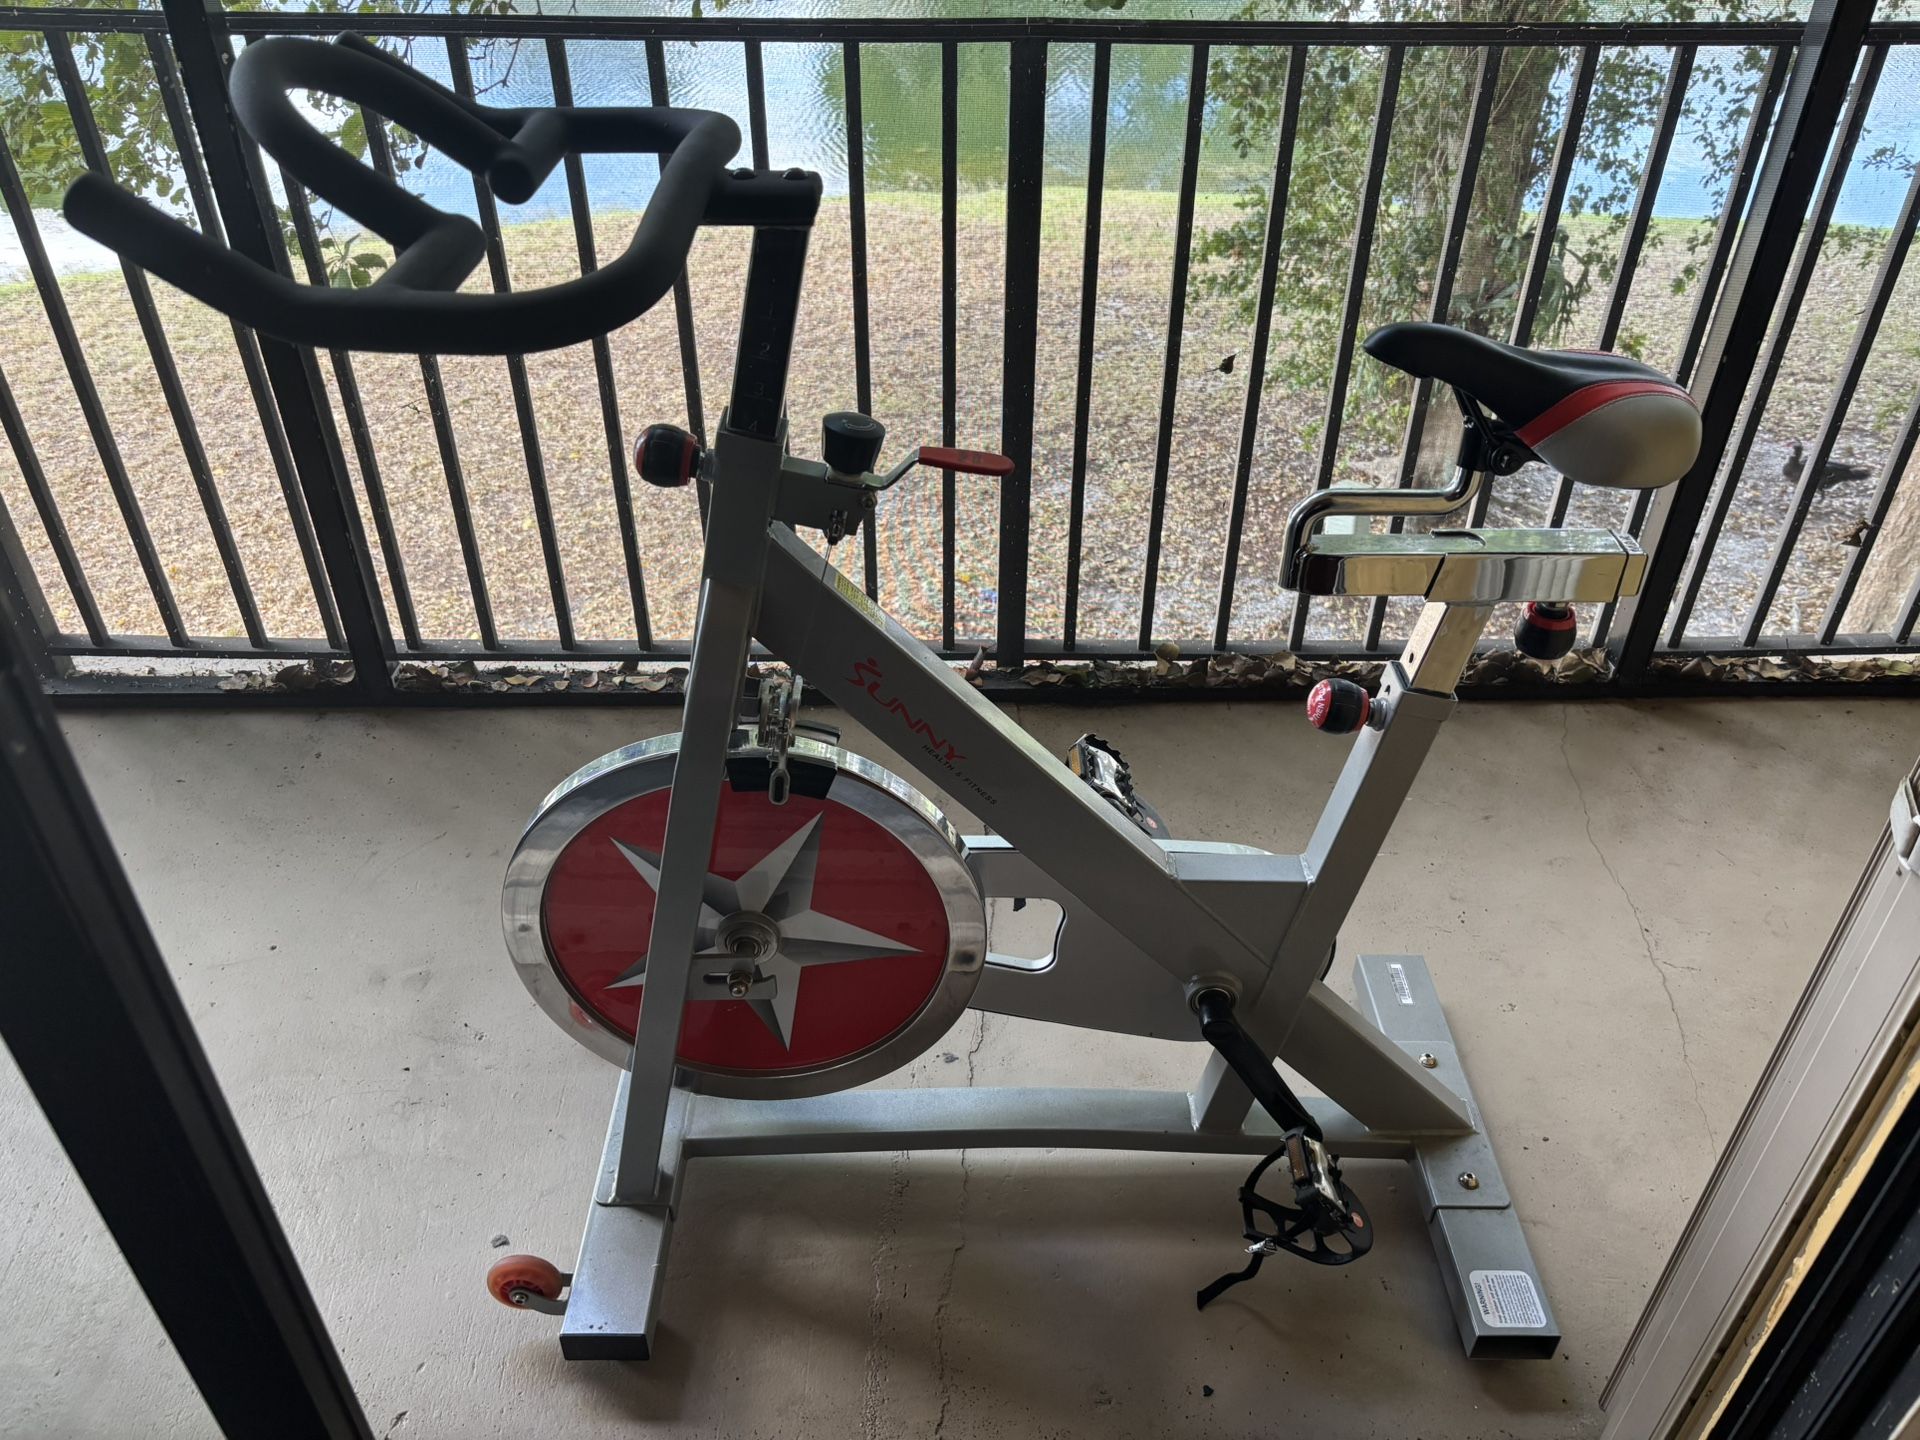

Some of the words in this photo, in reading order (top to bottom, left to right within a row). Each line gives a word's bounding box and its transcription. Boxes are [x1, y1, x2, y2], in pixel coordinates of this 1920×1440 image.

[759, 342, 771, 356] 2
[754, 381, 766, 397] 3
[747, 419, 758, 432] 4
[848, 656, 968, 762] SUNNY
[921, 744, 955, 771] HEALTH
[962, 776, 998, 805] FITNESS
